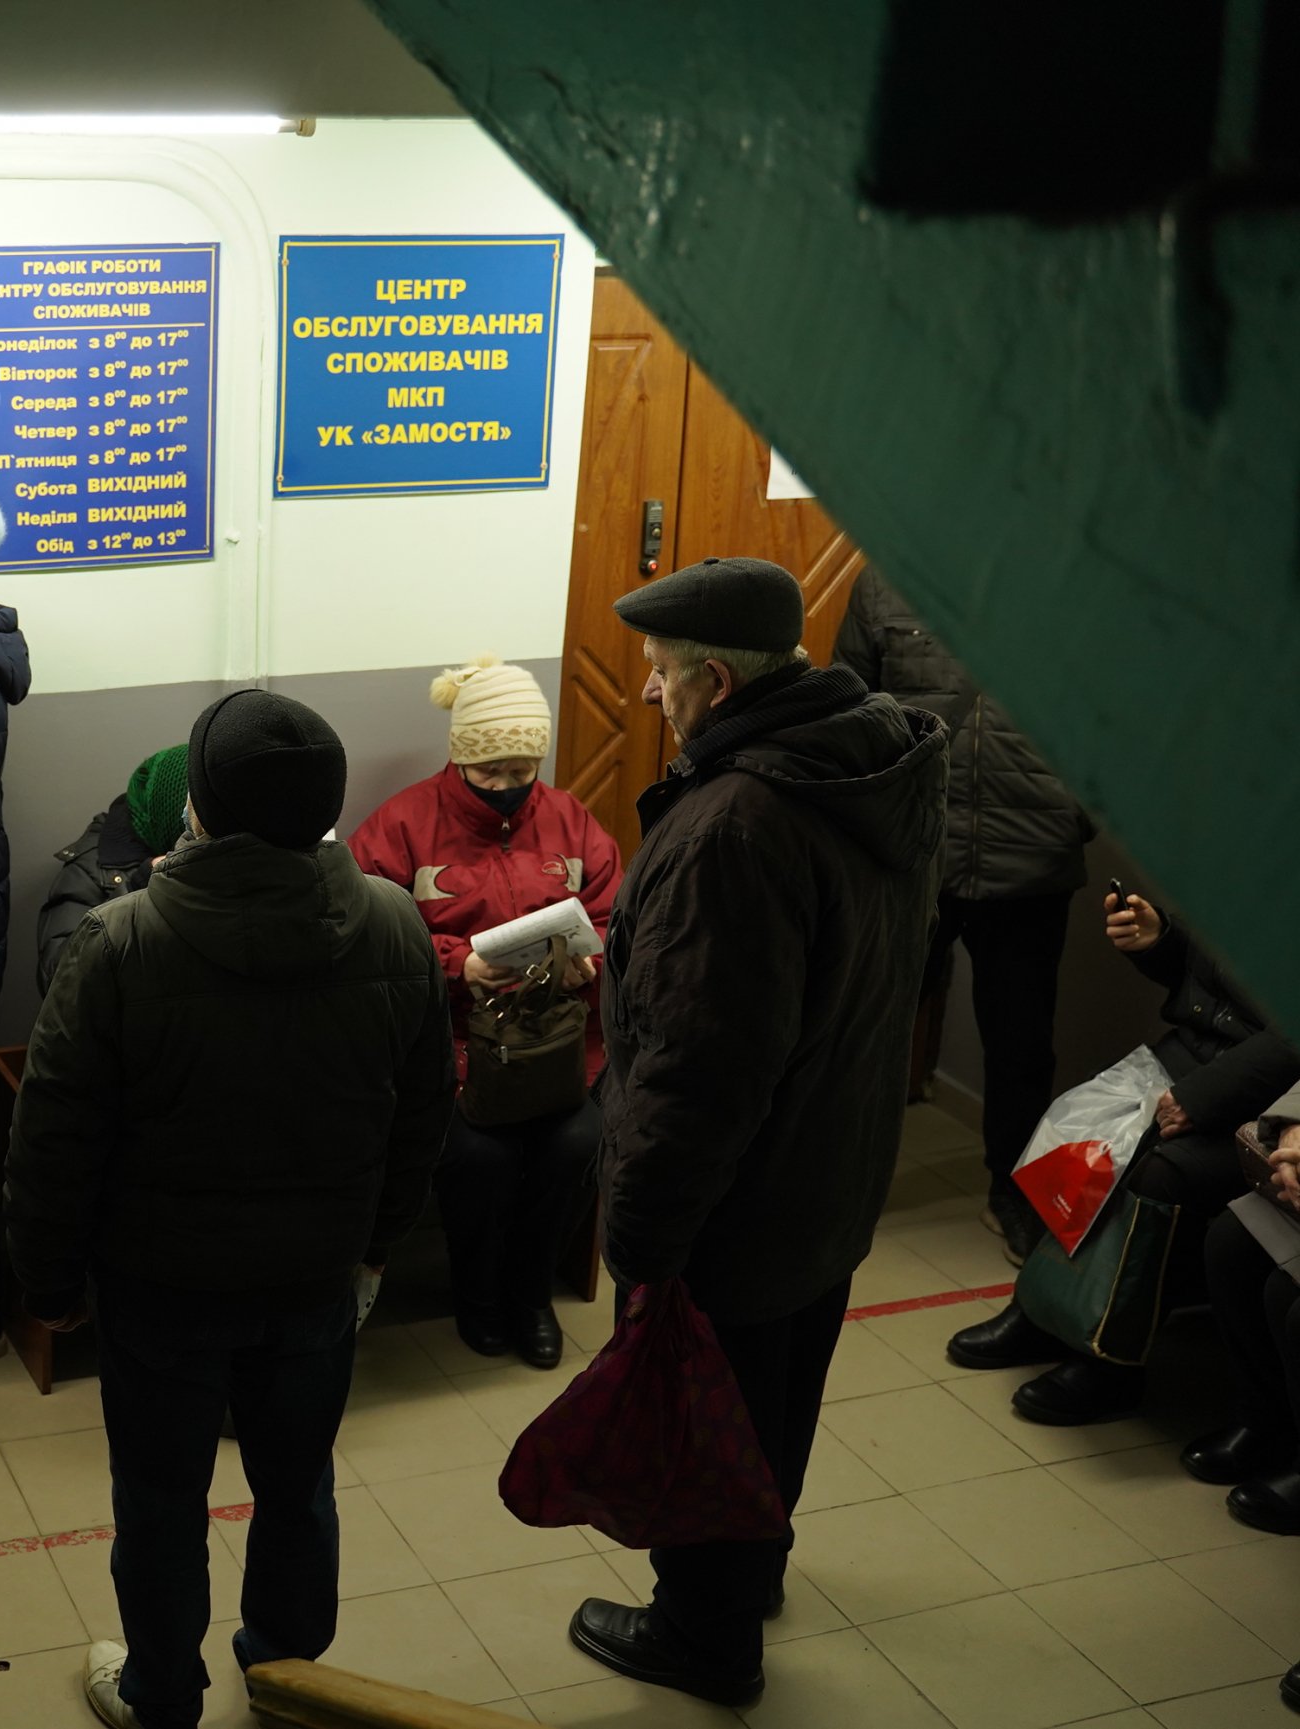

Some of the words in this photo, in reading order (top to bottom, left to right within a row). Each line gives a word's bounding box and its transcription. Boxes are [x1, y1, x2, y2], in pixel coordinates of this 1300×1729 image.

[23, 260, 86, 276] ГРАФІК
[91, 259, 161, 274] РОБОТИ
[47, 279, 207, 297] ОБСЛУГОВУВАННЯ
[375, 279, 466, 304] ЦЕНТР
[33, 303, 150, 320] СПОЖИВАЧІВ
[292, 313, 544, 338] ОБСЛУГОВУВАННЯ
[88, 337, 100, 349] з
[130, 336, 153, 350] до
[326, 350, 509, 374] СПОЖИВАЧІВ
[0, 366, 77, 383] Вівторок
[88, 366, 100, 378] з
[129, 365, 152, 380] до
[11, 395, 77, 412] Середа
[88, 395, 100, 408] з
[129, 394, 152, 409] до
[387, 387, 445, 408] МКП
[14, 425, 77, 442] Четвер
[88, 424, 100, 437] з
[129, 423, 152, 438] до
[317, 425, 354, 447] УК
[361, 421, 512, 445] «ЗАМОСТЯ»
[88, 453, 100, 466] з
[128, 452, 151, 467] до
[15, 483, 77, 500] Субота
[87, 471, 187, 494] ВИХІДНИЙ
[17, 511, 77, 527] Неділя
[87, 500, 187, 524] ВИХІДНИЙ
[36, 538, 74, 554] Обід
[87, 538, 98, 550] з
[132, 536, 153, 550] до
